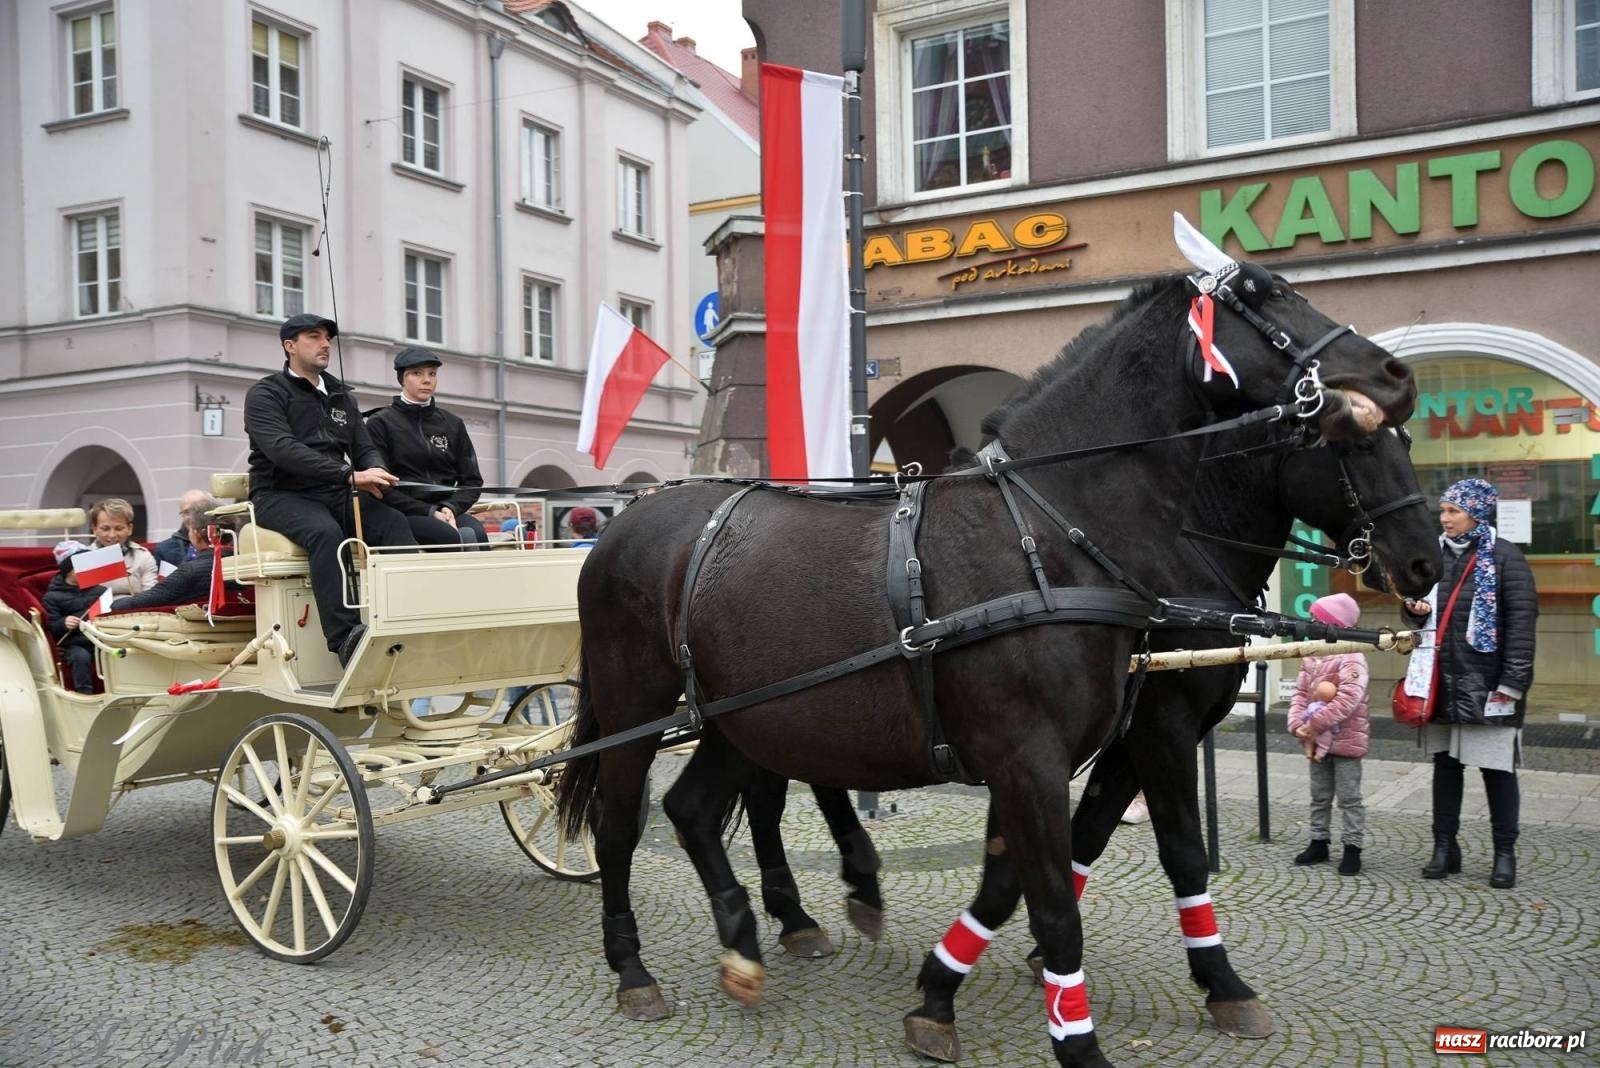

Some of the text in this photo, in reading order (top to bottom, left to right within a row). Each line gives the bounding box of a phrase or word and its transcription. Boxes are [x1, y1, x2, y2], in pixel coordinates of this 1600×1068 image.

[1200, 139, 1595, 253] KANTO
[847, 212, 1069, 270] ABAC
[951, 257, 1072, 291] pod arkadami
[1412, 386, 1535, 419] NTOR
